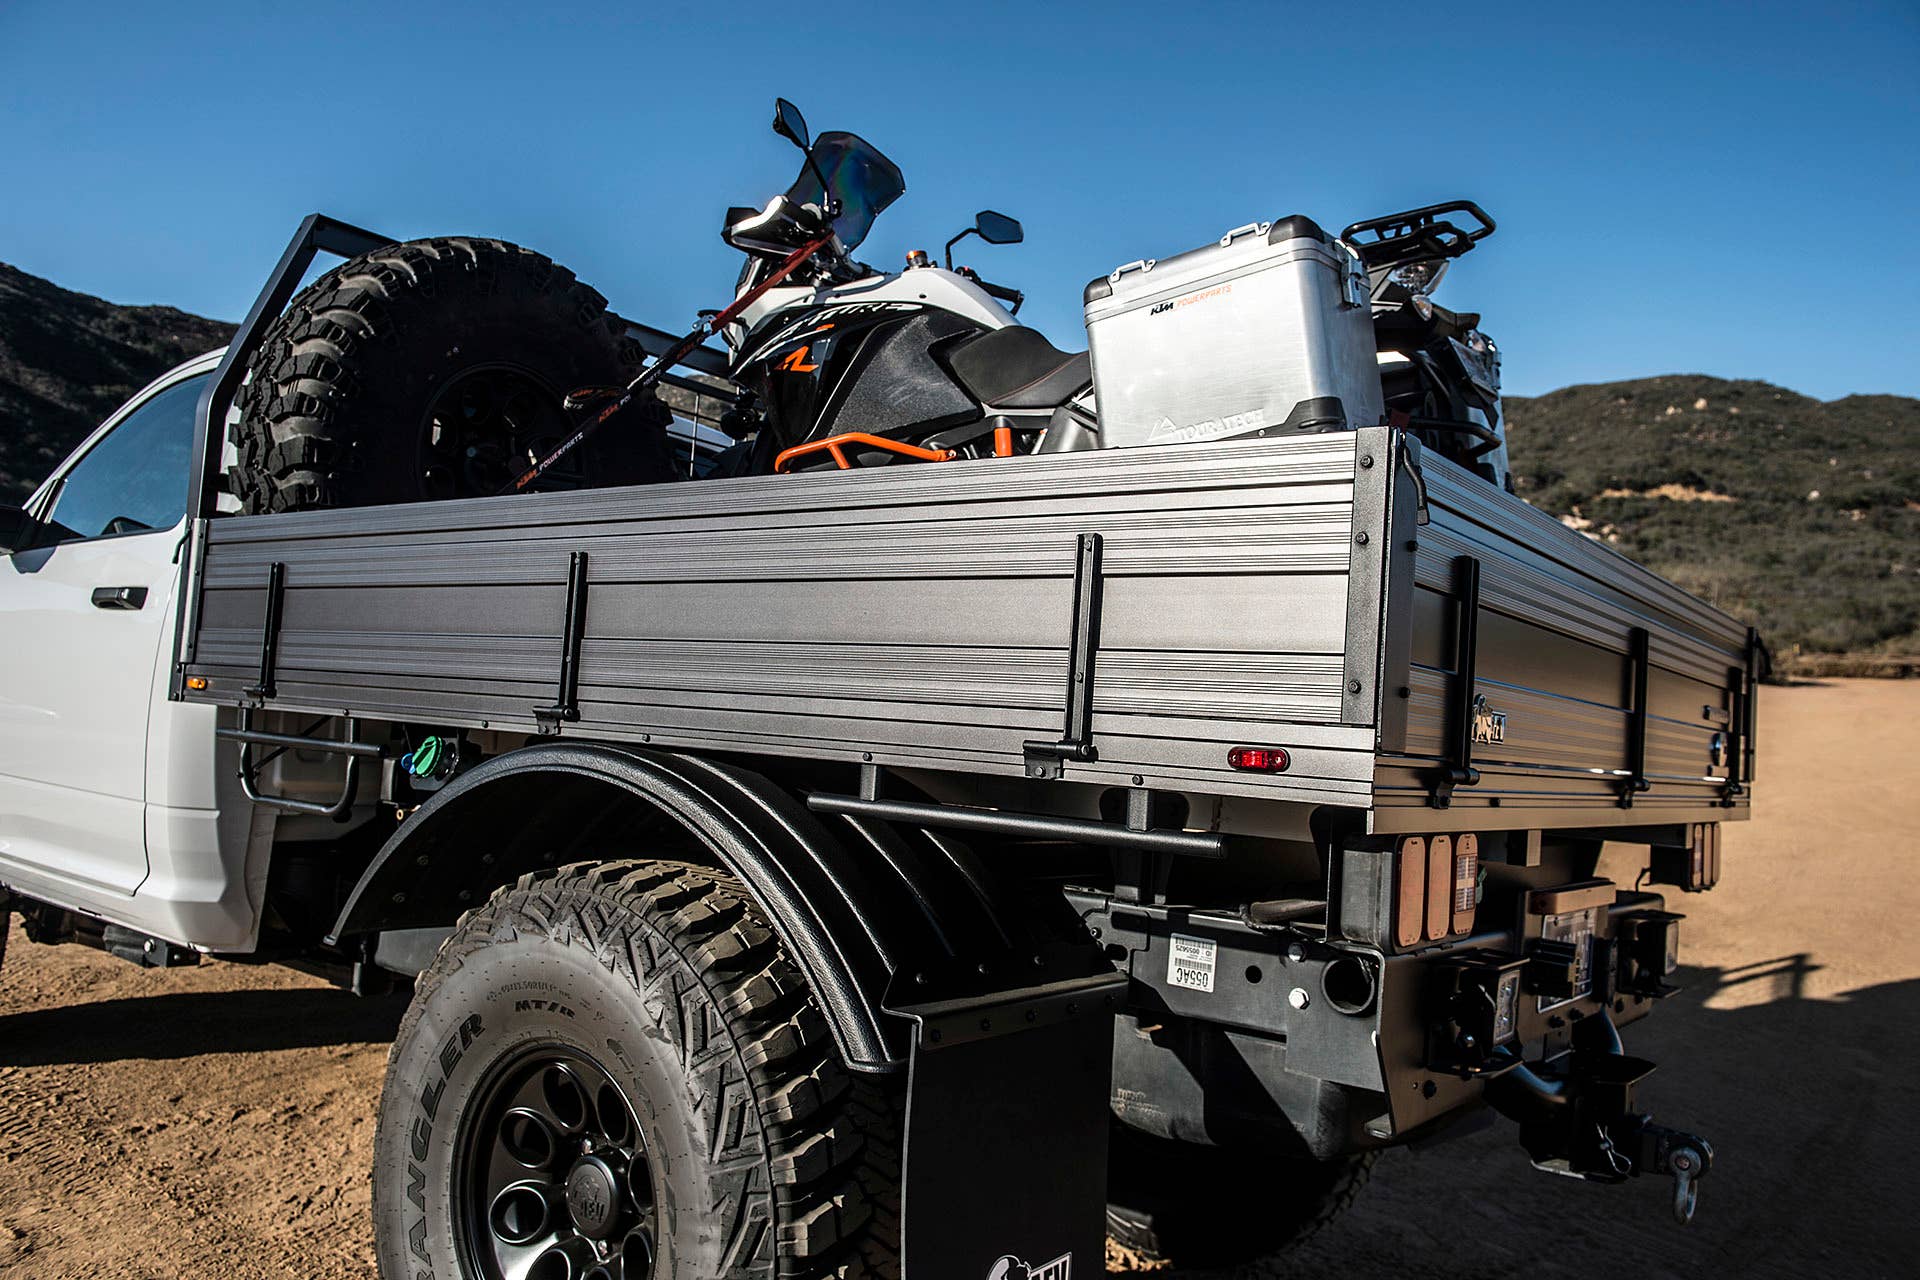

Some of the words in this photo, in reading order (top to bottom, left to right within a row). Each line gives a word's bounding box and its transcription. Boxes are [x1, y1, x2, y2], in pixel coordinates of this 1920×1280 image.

[1150, 302, 1174, 316] KTM
[1176, 285, 1233, 307] POWERPARTS
[1174, 408, 1265, 440] TOURATECH
[539, 431, 584, 472] POWERPARTS
[1176, 967, 1209, 988] 055AC
[515, 999, 578, 1020] MT/R
[407, 1013, 486, 1280] ANGLER
